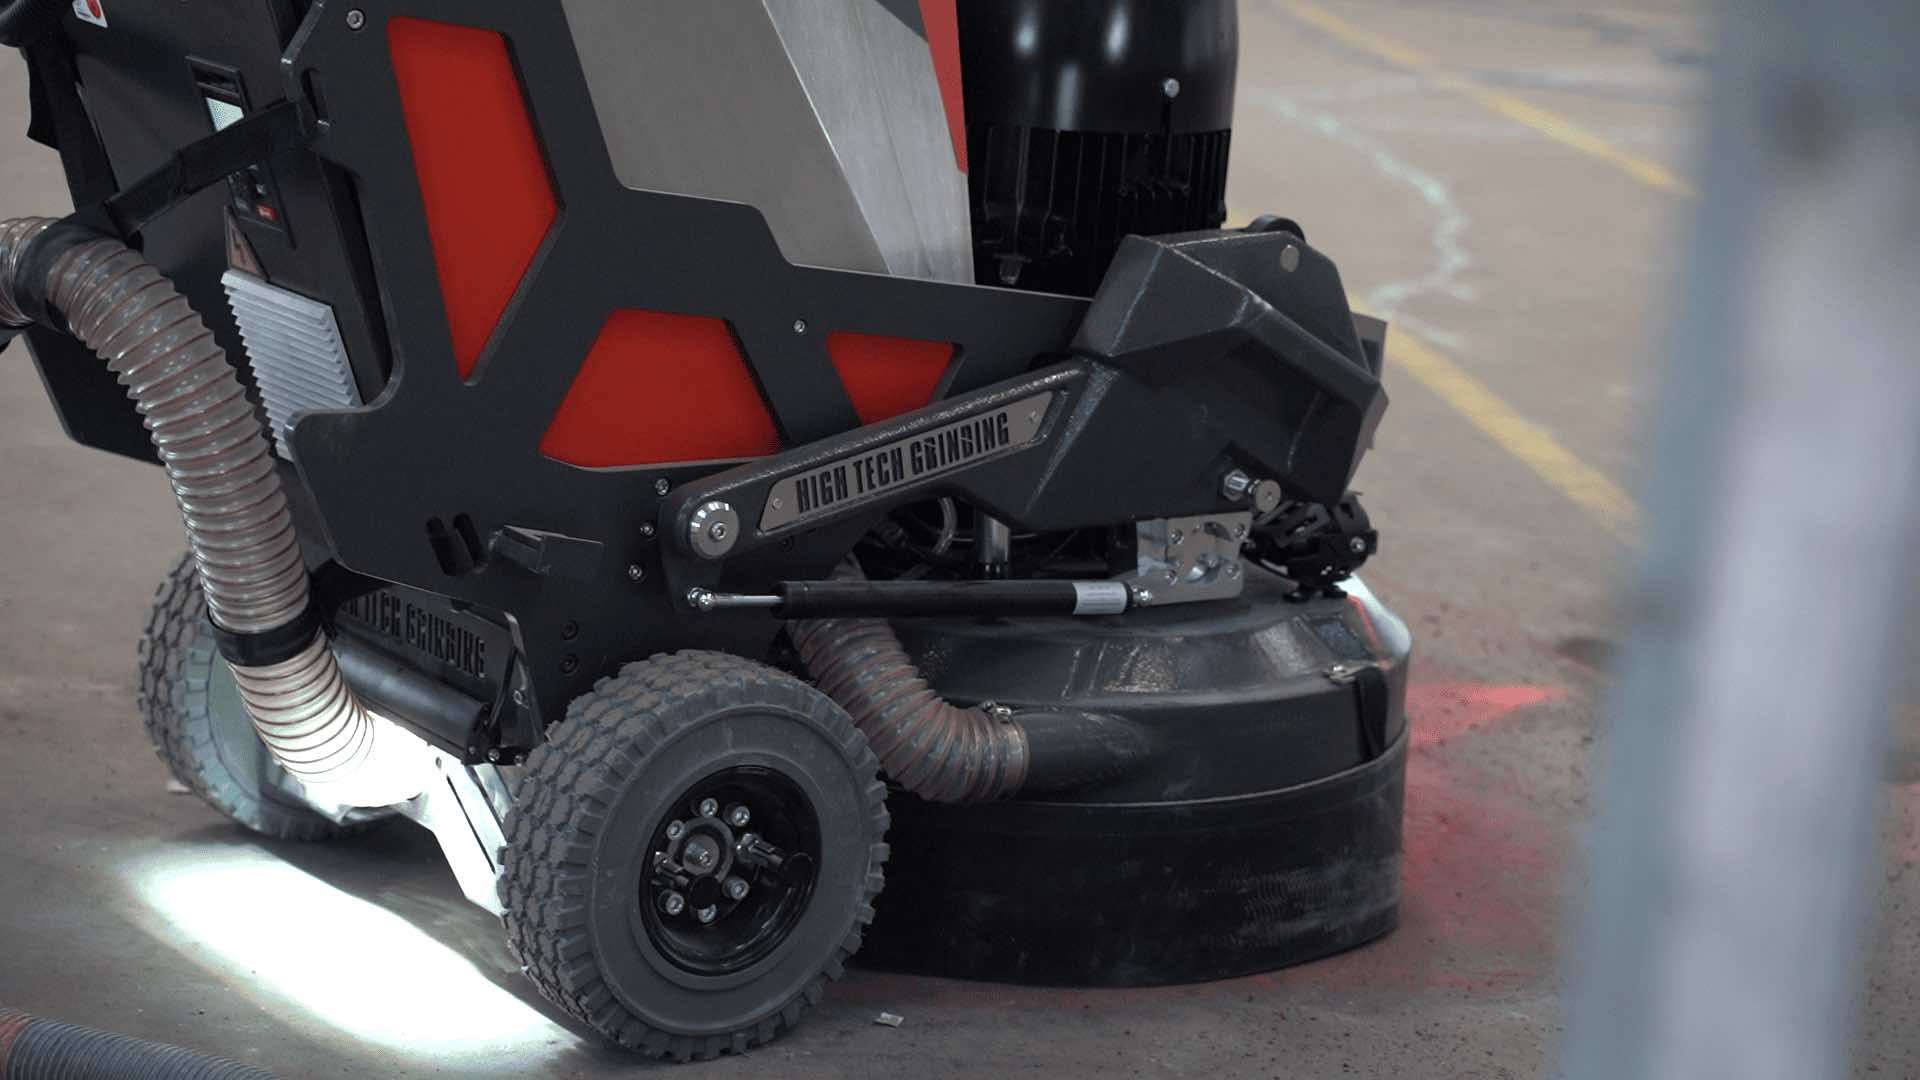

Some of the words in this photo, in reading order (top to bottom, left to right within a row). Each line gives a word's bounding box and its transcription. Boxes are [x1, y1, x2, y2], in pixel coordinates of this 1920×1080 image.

[795, 465, 848, 513] HIGH
[852, 447, 904, 494] TECH
[910, 412, 1010, 476] GRINDING
